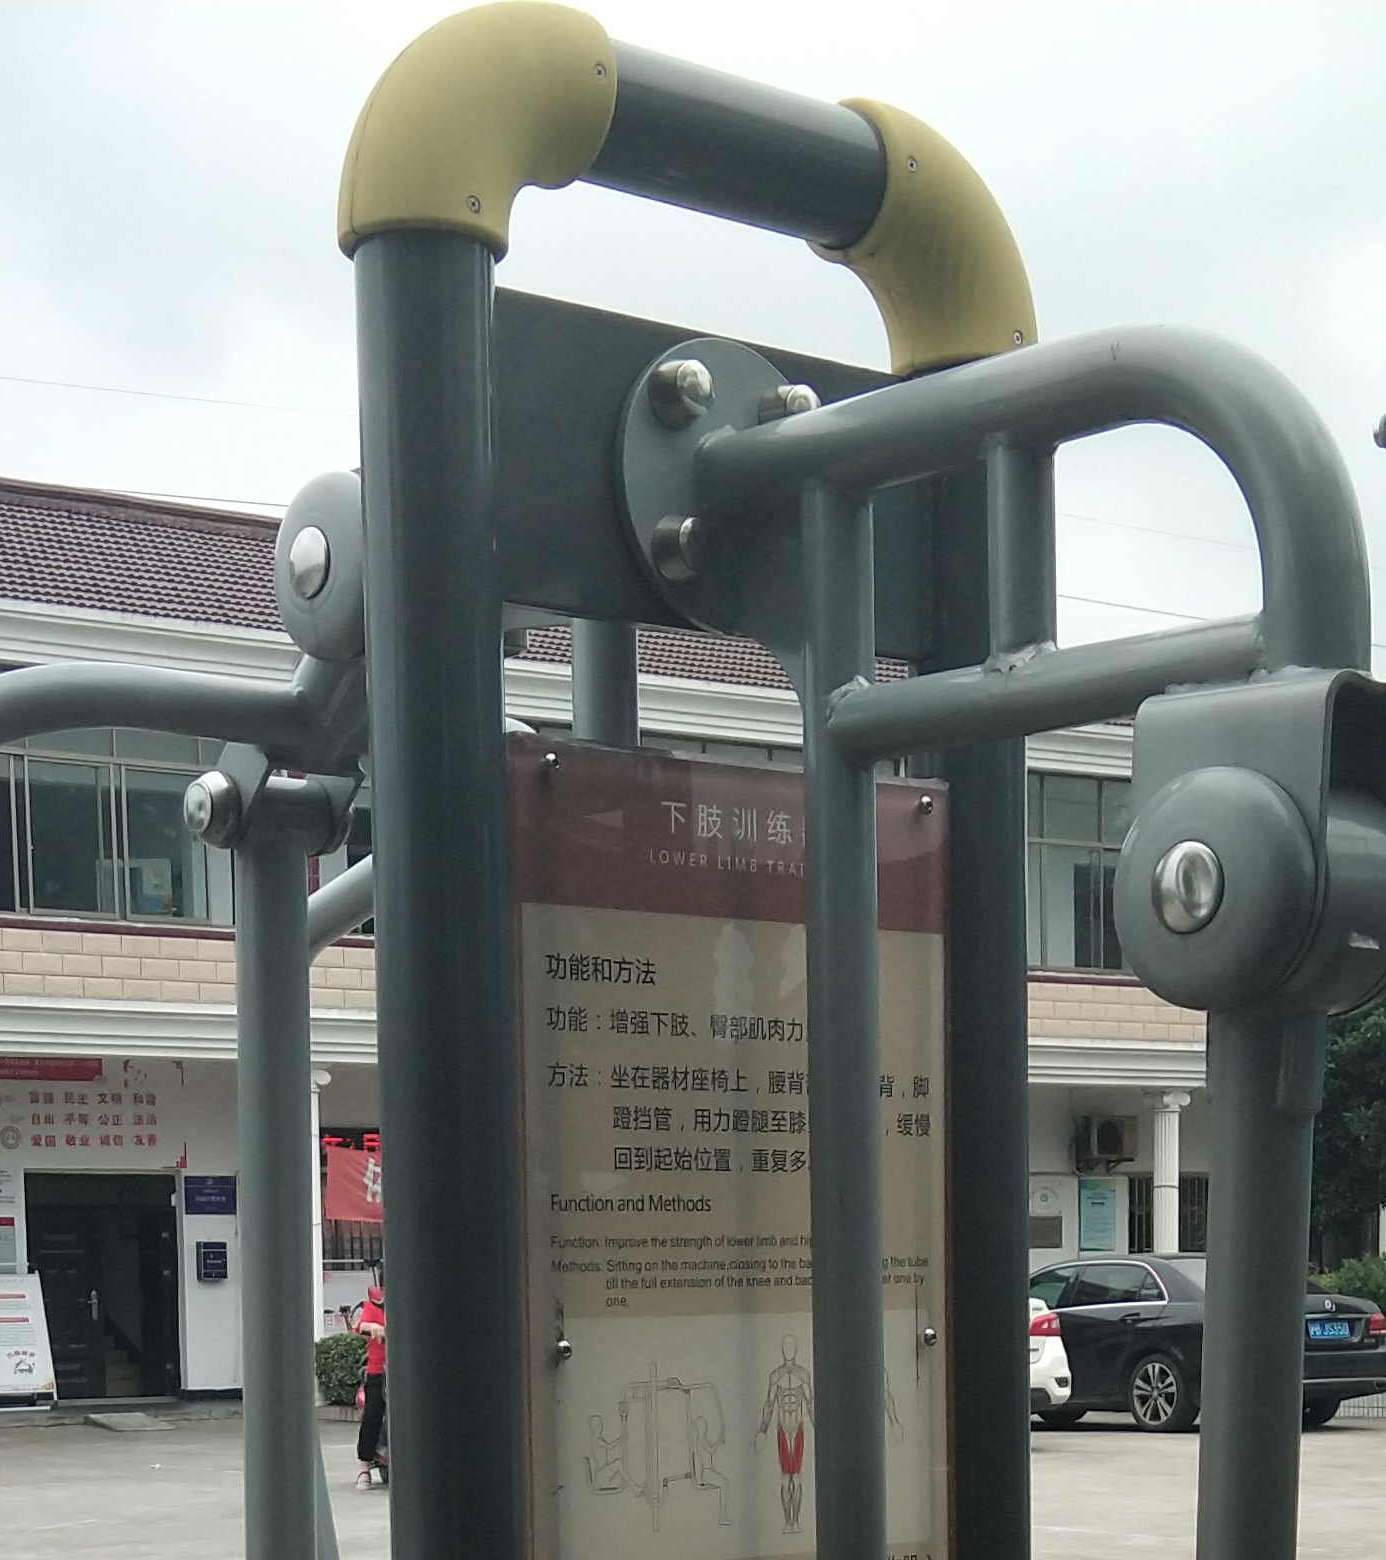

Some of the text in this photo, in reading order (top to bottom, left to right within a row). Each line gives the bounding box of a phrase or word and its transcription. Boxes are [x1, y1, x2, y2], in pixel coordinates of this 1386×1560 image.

[660, 800, 804, 844] 下肢训练
[650, 849, 708, 869] LOWER
[545, 953, 656, 986] 功能和方法
[546, 1006, 807, 1042] 功能：增强下肢、臀部肌肉力
[547, 1062, 809, 1096] 方法：坐在器材座椅上，腰背
[97, 1092, 122, 1105] 文明
[98, 1113, 123, 1126] 公正
[613, 1105, 810, 1134] 蹬挡管，用力蹬腿至膝
[31, 1134, 56, 1147] 爱国
[613, 1147, 810, 1174] 回到起始位置，重复多
[551, 1194, 712, 1212] Function and Methods
[605, 1236, 649, 1250] Improve
[651, 1235, 668, 1248] the
[670, 1235, 712, 1250] strength
[714, 1235, 725, 1248] of
[727, 1235, 754, 1248] lower
[779, 1235, 798, 1246] and
[606, 1259, 642, 1274] Sitting
[644, 1261, 658, 1272] on
[661, 1259, 678, 1272] the
[768, 1258, 779, 1270] to
[780, 1258, 796, 1269] the
[621, 1277, 639, 1289] the
[660, 1276, 713, 1289] extension
[714, 1275, 725, 1288] of
[727, 1275, 743, 1287] the
[746, 1275, 771, 1287] knee
[773, 1275, 793, 1286] and
